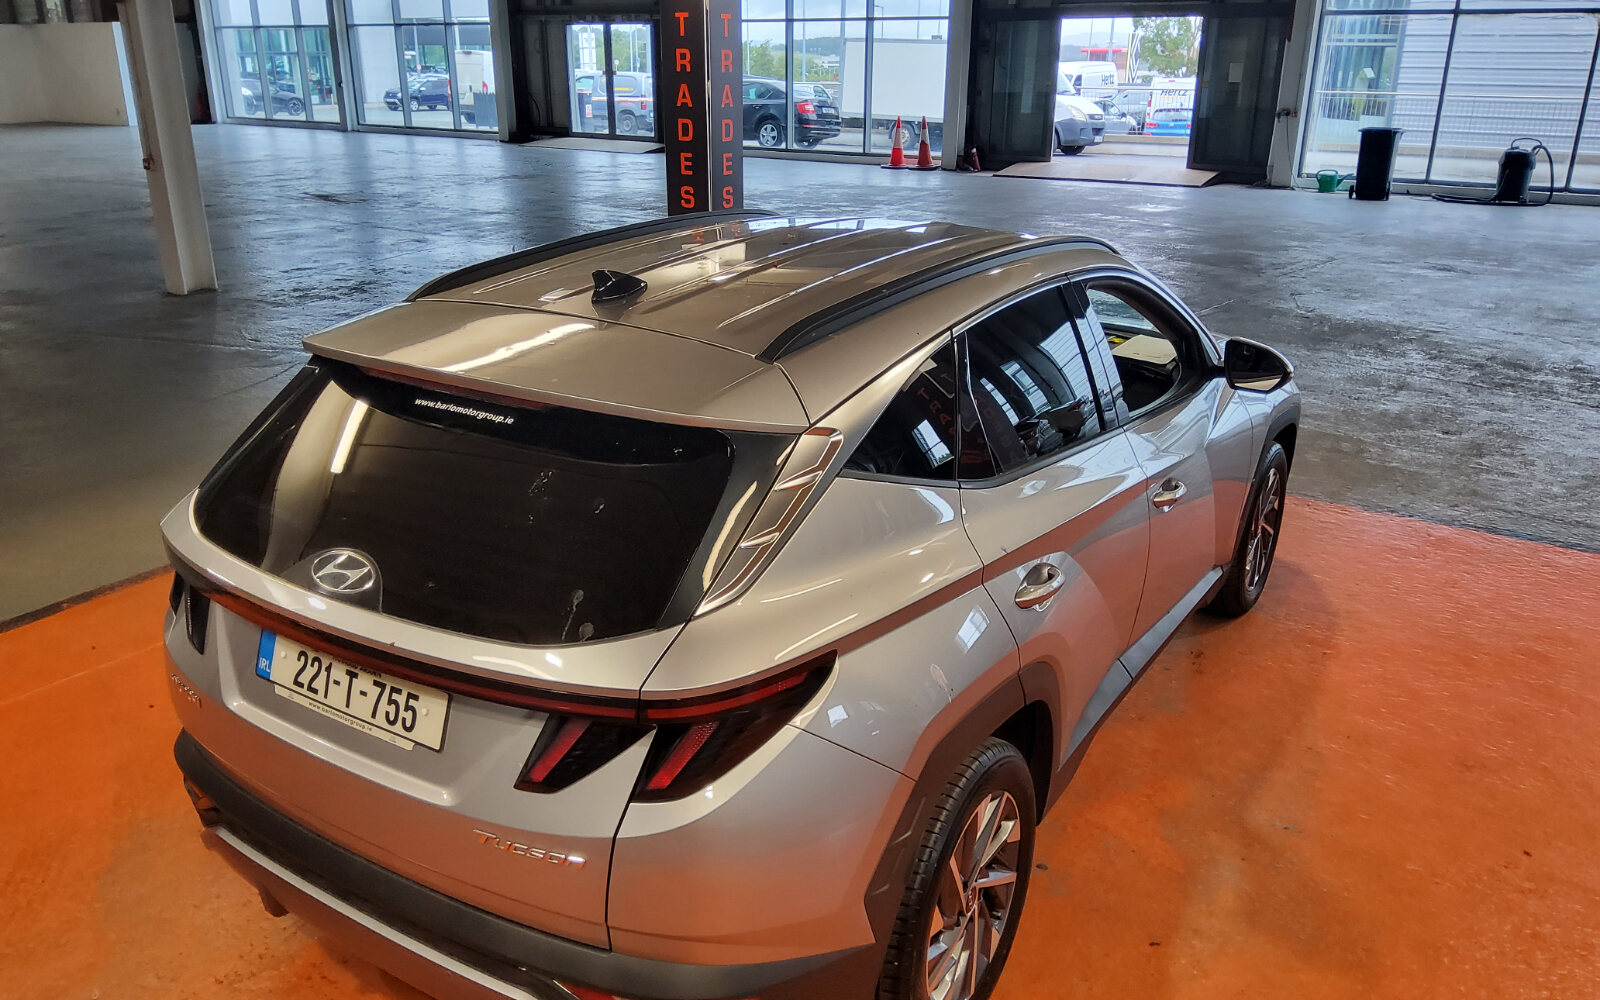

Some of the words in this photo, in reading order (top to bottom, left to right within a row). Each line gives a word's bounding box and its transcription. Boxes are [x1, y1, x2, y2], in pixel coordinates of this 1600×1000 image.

[675, 12, 695, 209] TRADES
[720, 13, 735, 209] TRADES
[258, 657, 271, 673] IRL
[293, 650, 420, 733] 221-T-755
